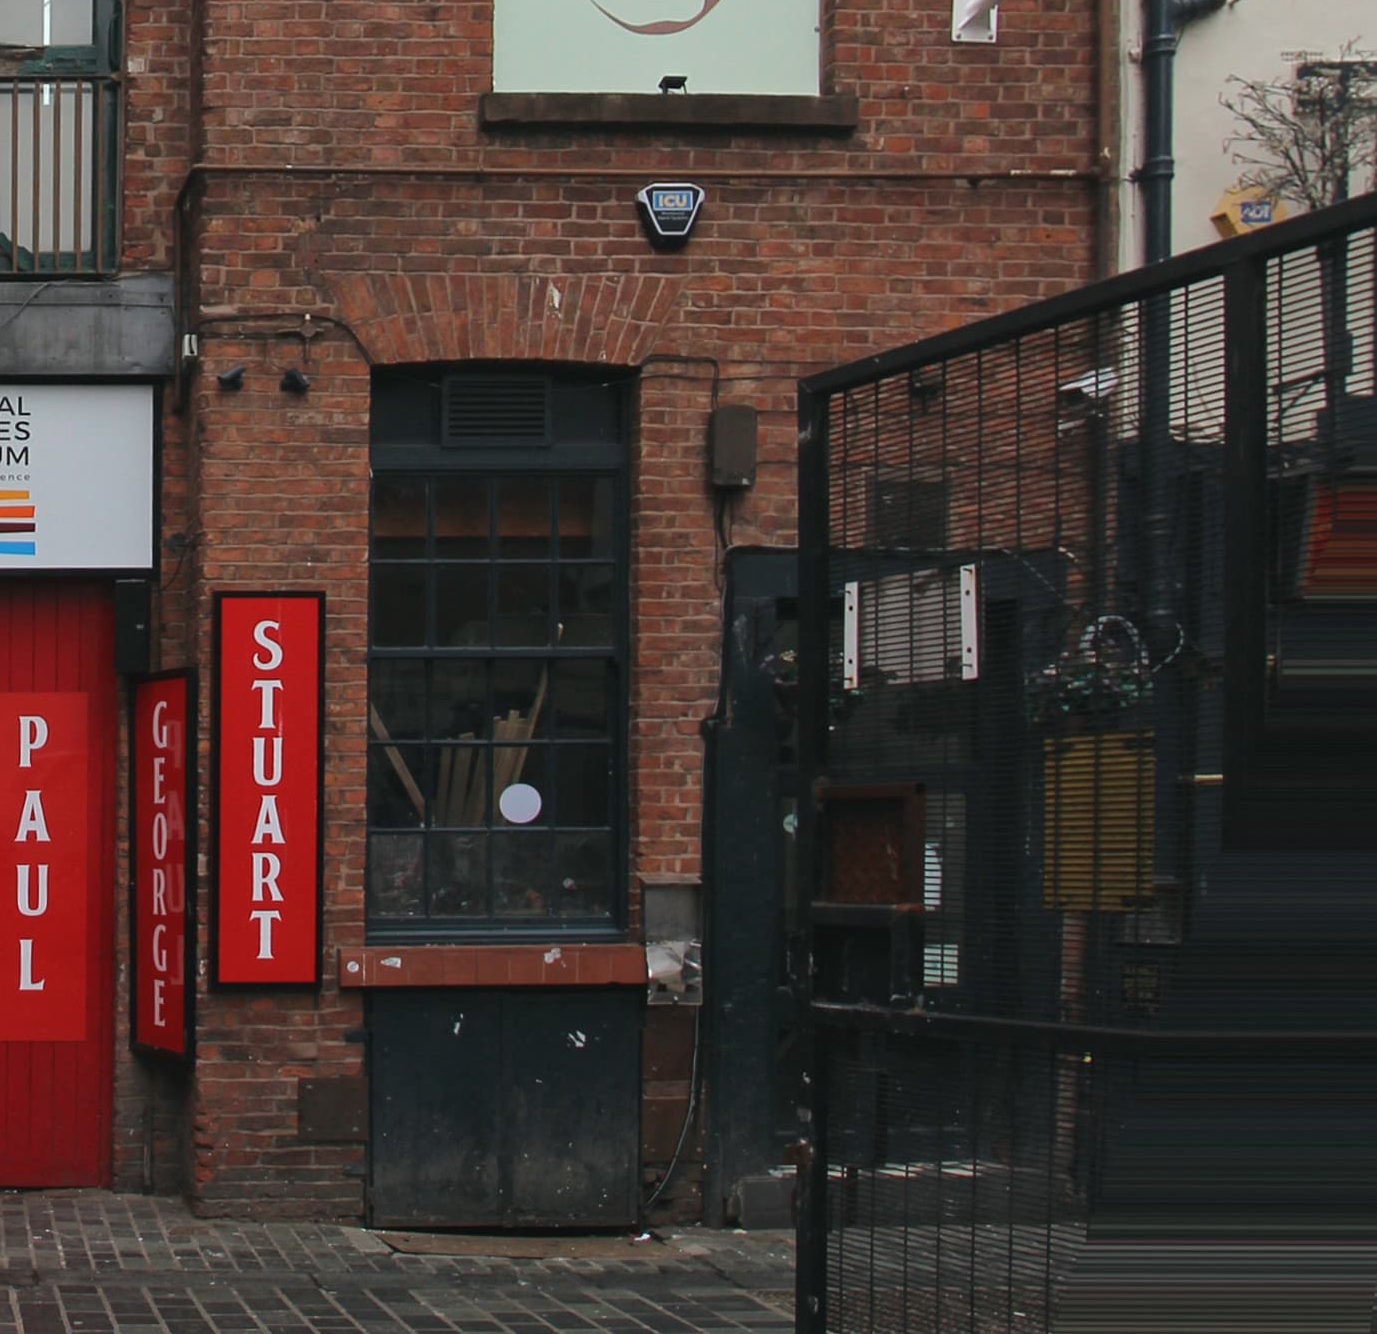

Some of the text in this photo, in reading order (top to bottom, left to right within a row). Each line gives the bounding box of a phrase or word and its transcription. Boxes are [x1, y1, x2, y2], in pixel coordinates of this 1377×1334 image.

[658, 194, 688, 208] ICU
[14, 715, 51, 991] PAUL
[152, 700, 168, 1027] GEORGE
[249, 619, 287, 960] STUART
